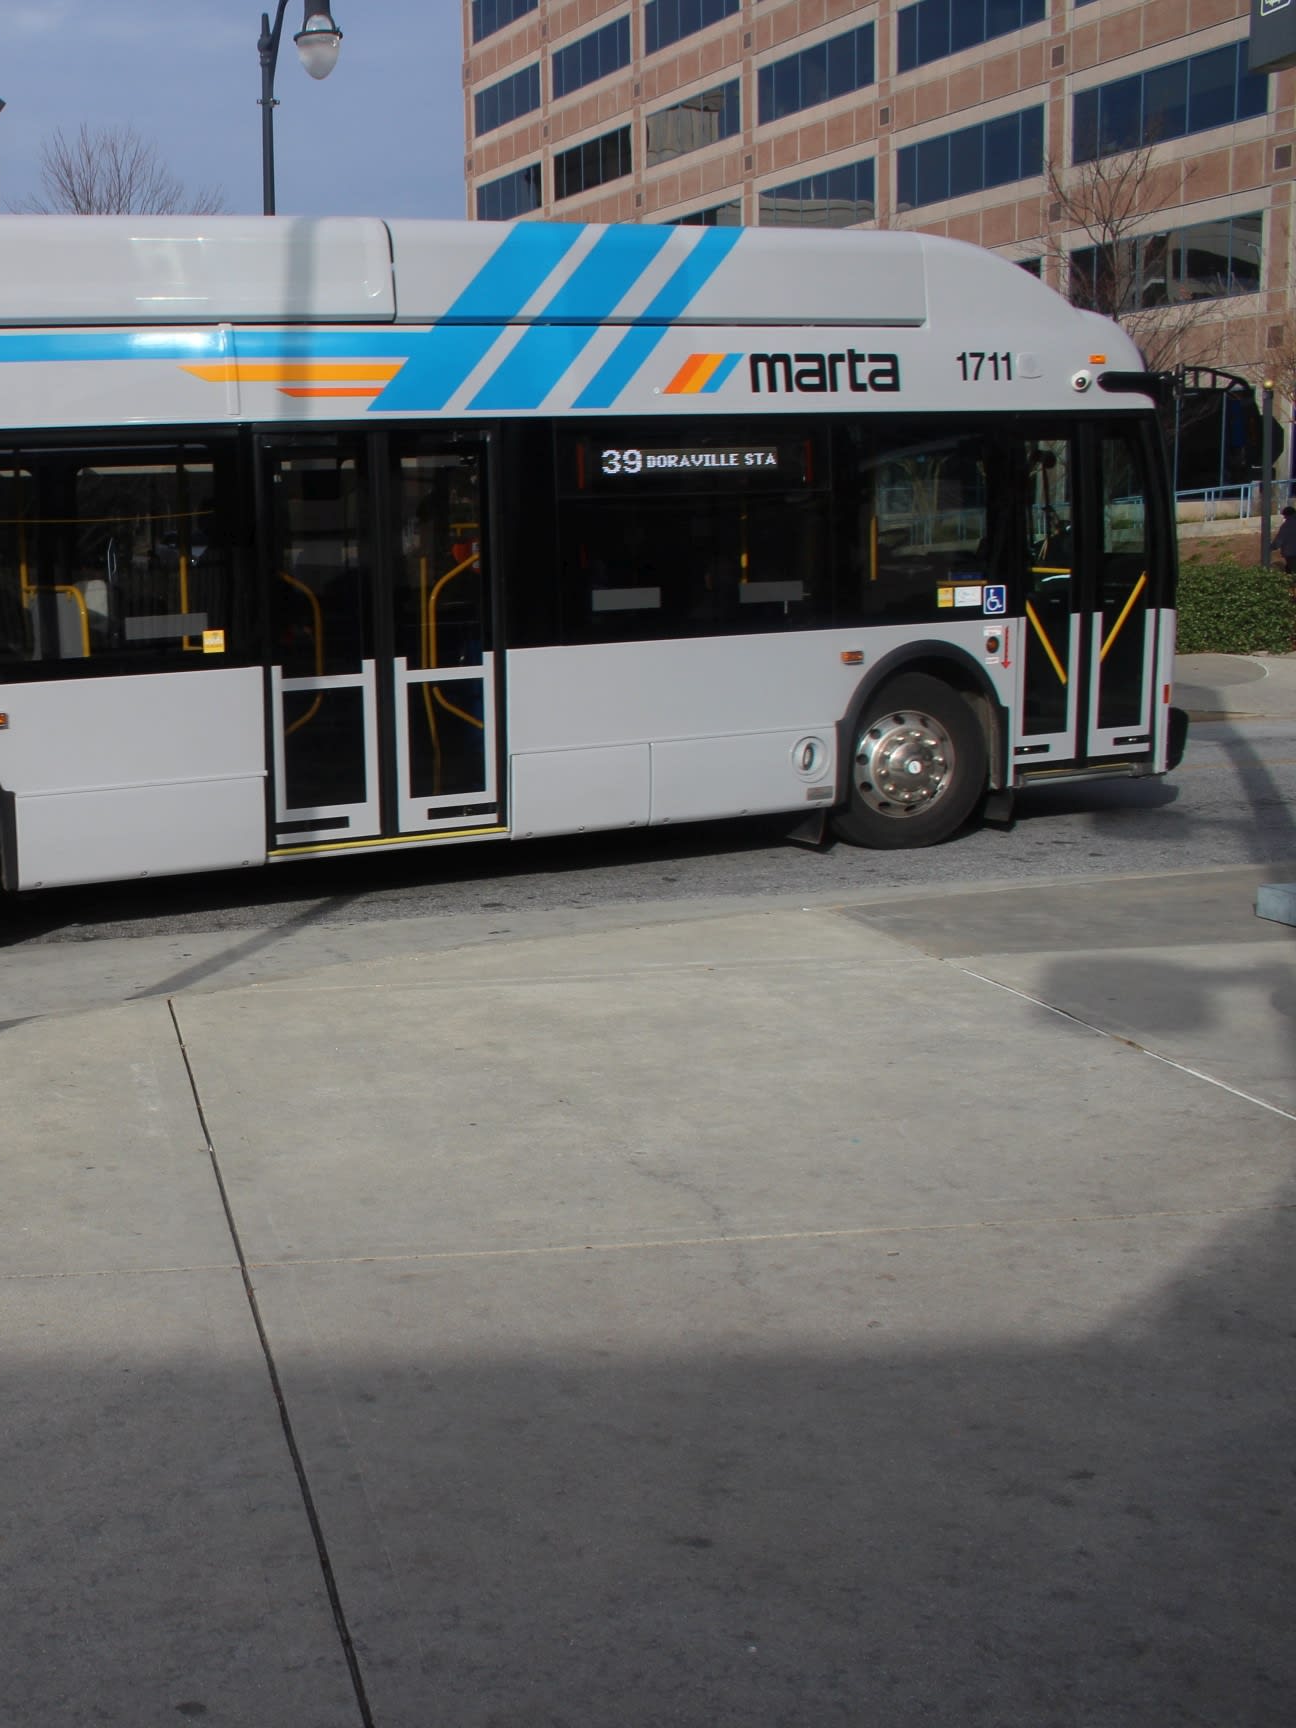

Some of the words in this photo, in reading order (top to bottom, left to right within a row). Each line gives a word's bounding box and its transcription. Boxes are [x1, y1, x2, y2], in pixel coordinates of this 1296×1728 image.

[749, 348, 901, 393] marta
[956, 351, 1013, 382] 1711
[601, 449, 643, 474] 39
[646, 453, 740, 468] DORAVILLE
[744, 452, 777, 466] STA
